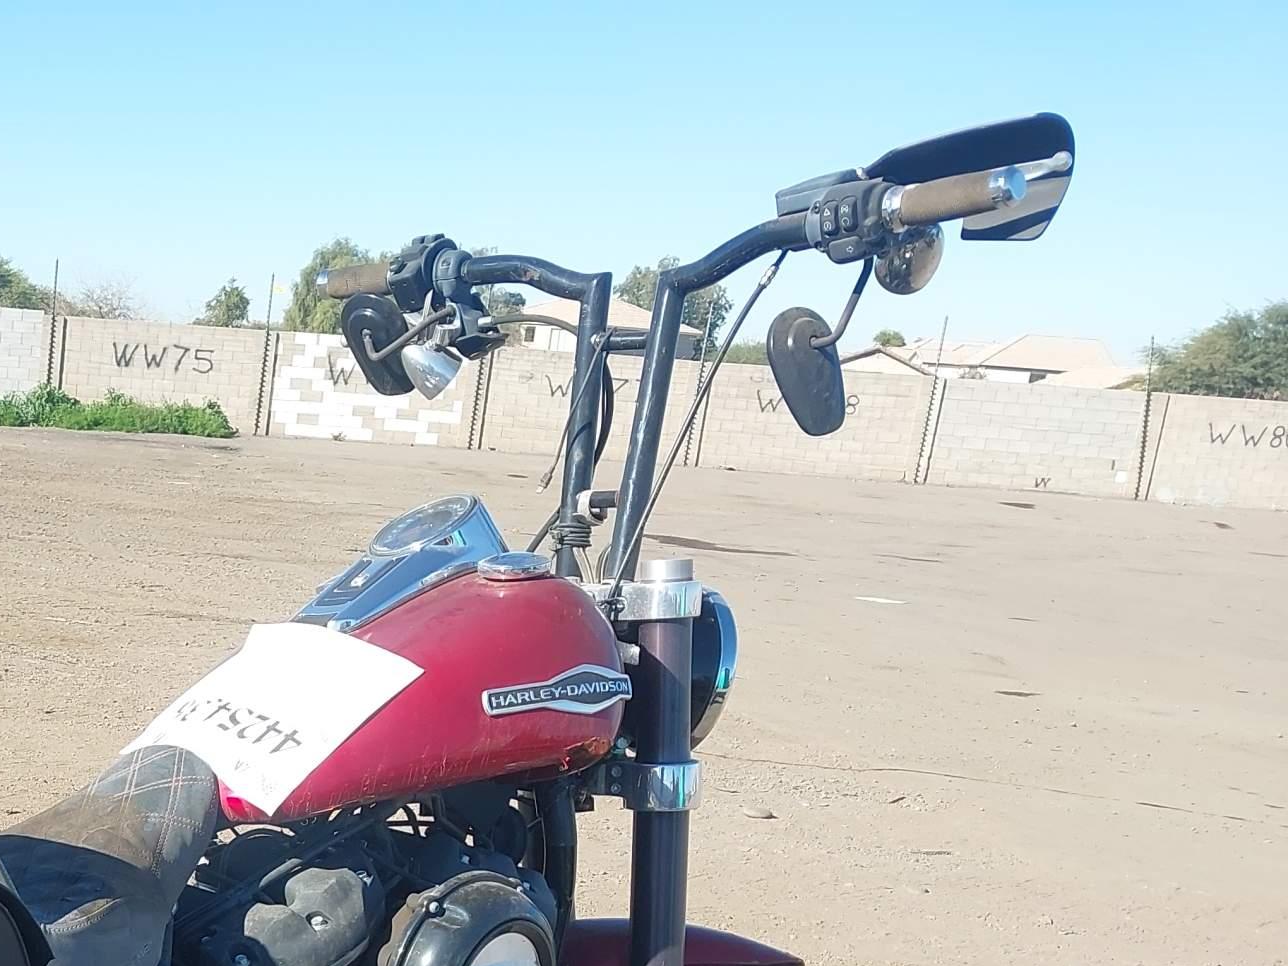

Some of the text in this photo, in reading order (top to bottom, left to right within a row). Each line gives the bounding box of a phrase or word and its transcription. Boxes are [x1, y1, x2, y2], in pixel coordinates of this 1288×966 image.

[112, 341, 215, 374] WW75
[1208, 422, 1288, 448] WW8
[490, 680, 629, 708] HARLEY-DAVIDSON
